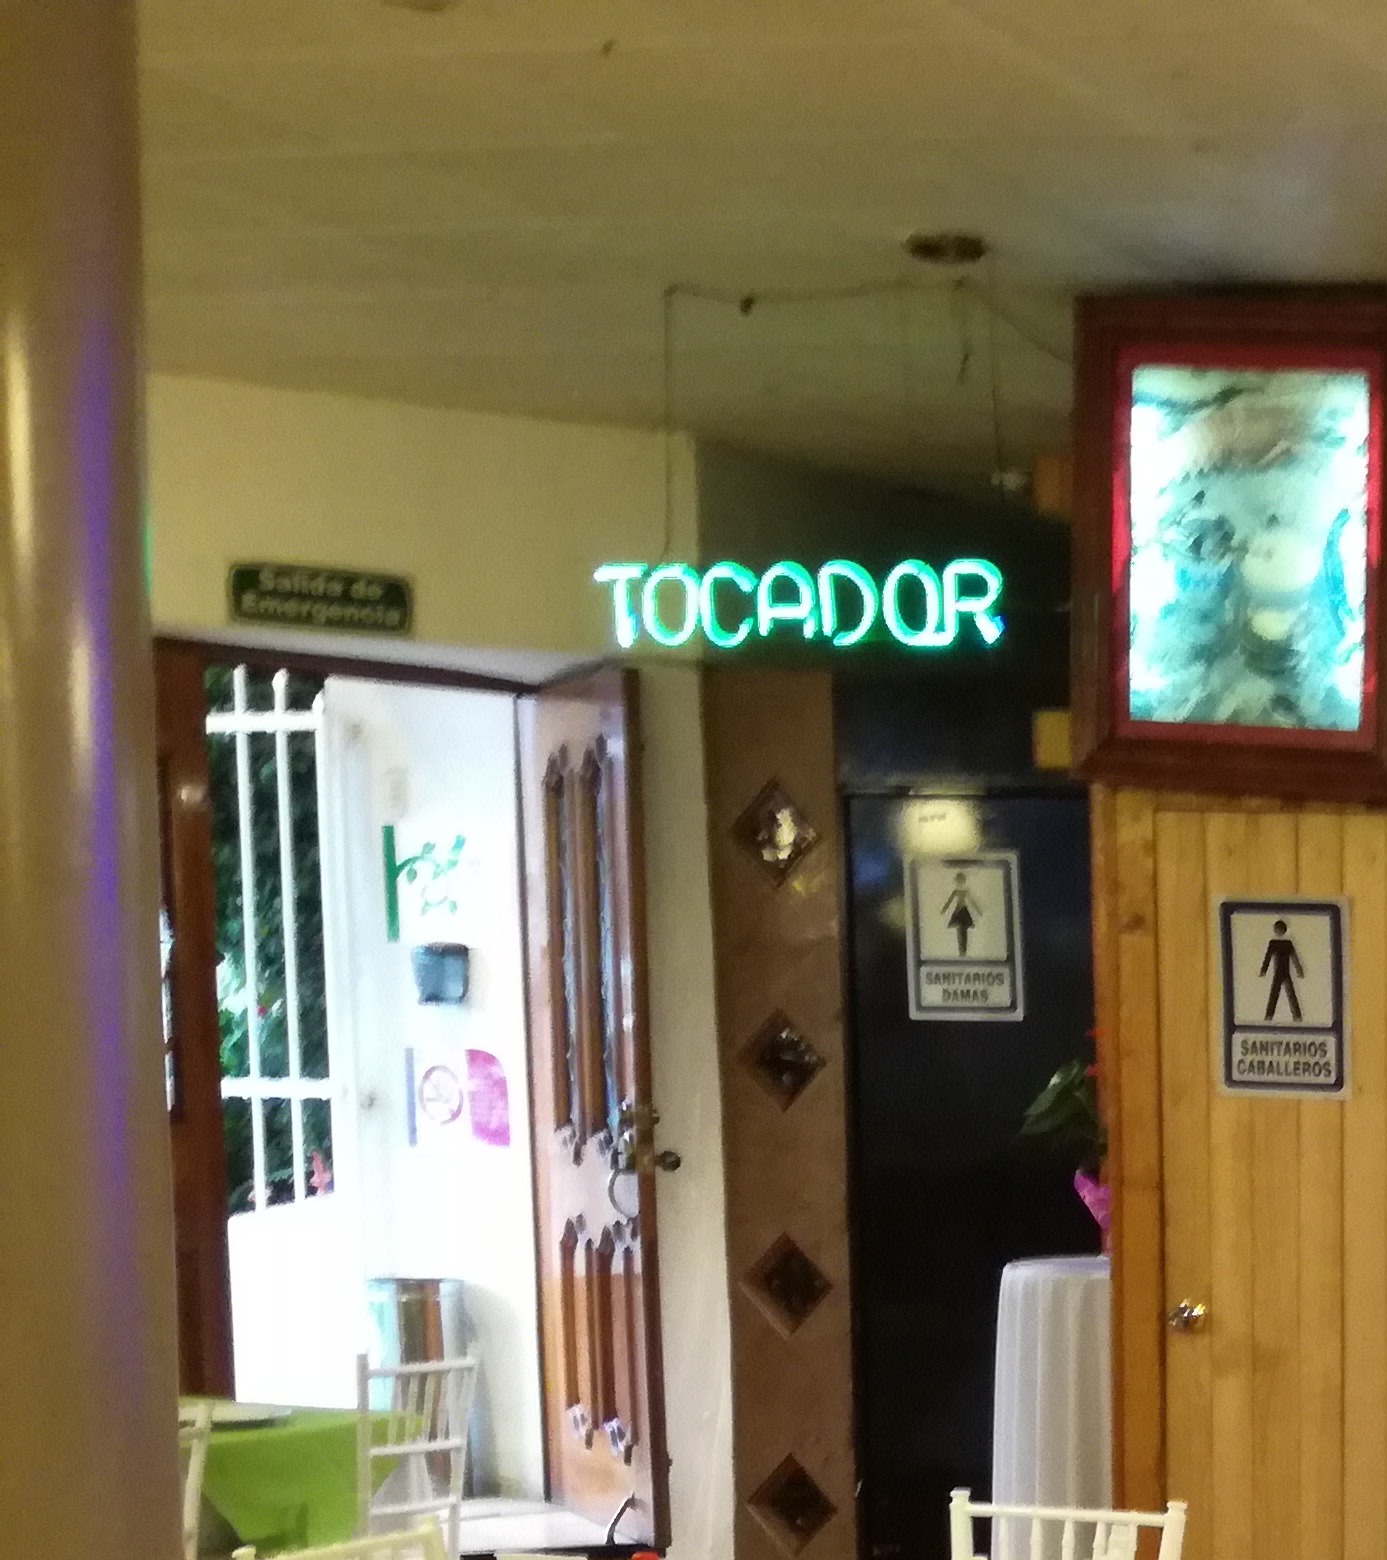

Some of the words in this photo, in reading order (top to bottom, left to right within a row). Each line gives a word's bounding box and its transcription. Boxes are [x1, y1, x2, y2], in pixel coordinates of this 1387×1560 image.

[259, 563, 343, 597] Salida
[350, 579, 384, 601] de
[241, 591, 400, 626] Emergencia
[594, 558, 1005, 648] TOCADOR
[925, 971, 1005, 987] SANITARIOS
[942, 989, 988, 1004] DAMAS
[1240, 1039, 1328, 1059] SANITARIOS
[1236, 1059, 1332, 1078] CABALLEROS
